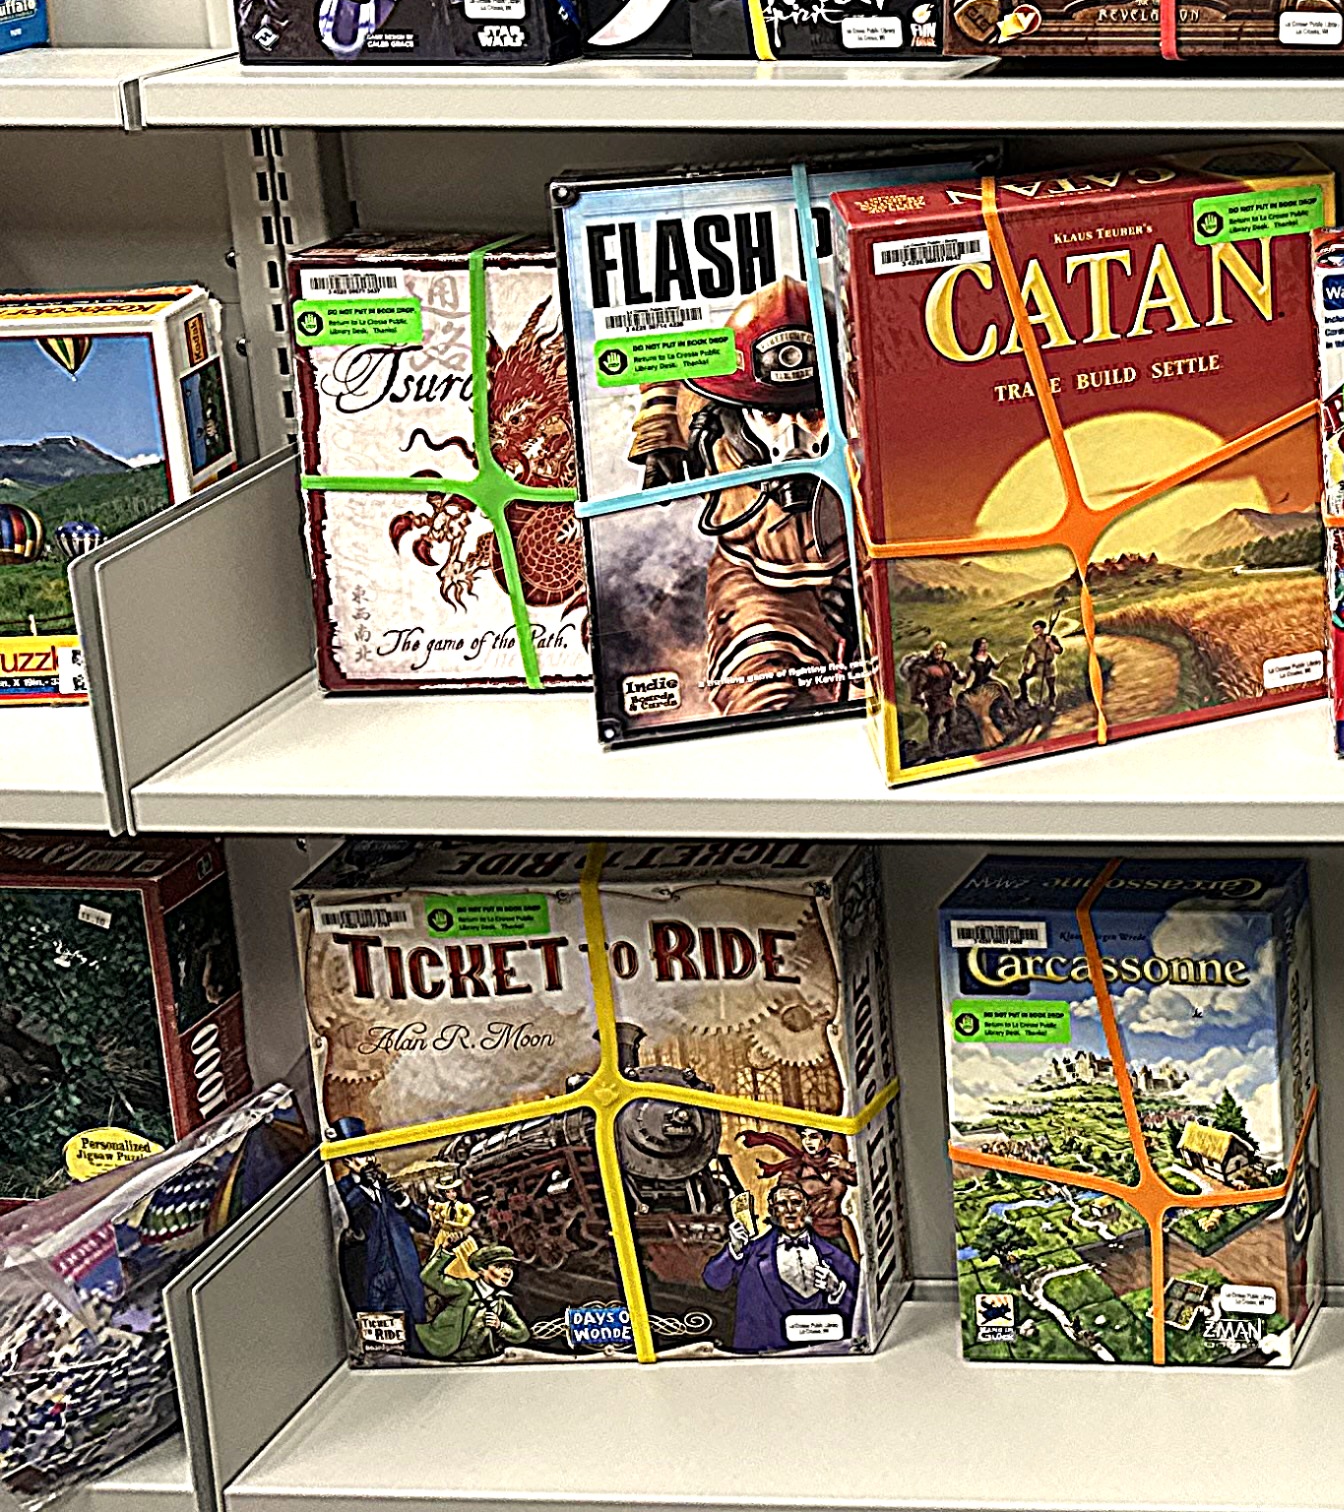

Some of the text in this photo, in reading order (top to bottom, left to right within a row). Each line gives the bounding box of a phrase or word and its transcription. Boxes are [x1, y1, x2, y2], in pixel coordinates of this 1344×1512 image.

[1054, 230, 1094, 244] KLAUS
[585, 211, 777, 309] FLASH
[924, 236, 1275, 363] CATAN
[1076, 356, 1220, 391] BUILD SETTLE
[625, 677, 678, 694] Indie
[332, 919, 801, 1003] TICKET RIDE
[966, 947, 1251, 987] Carcassonne
[358, 1020, 556, 1056] Alan R. Moon
